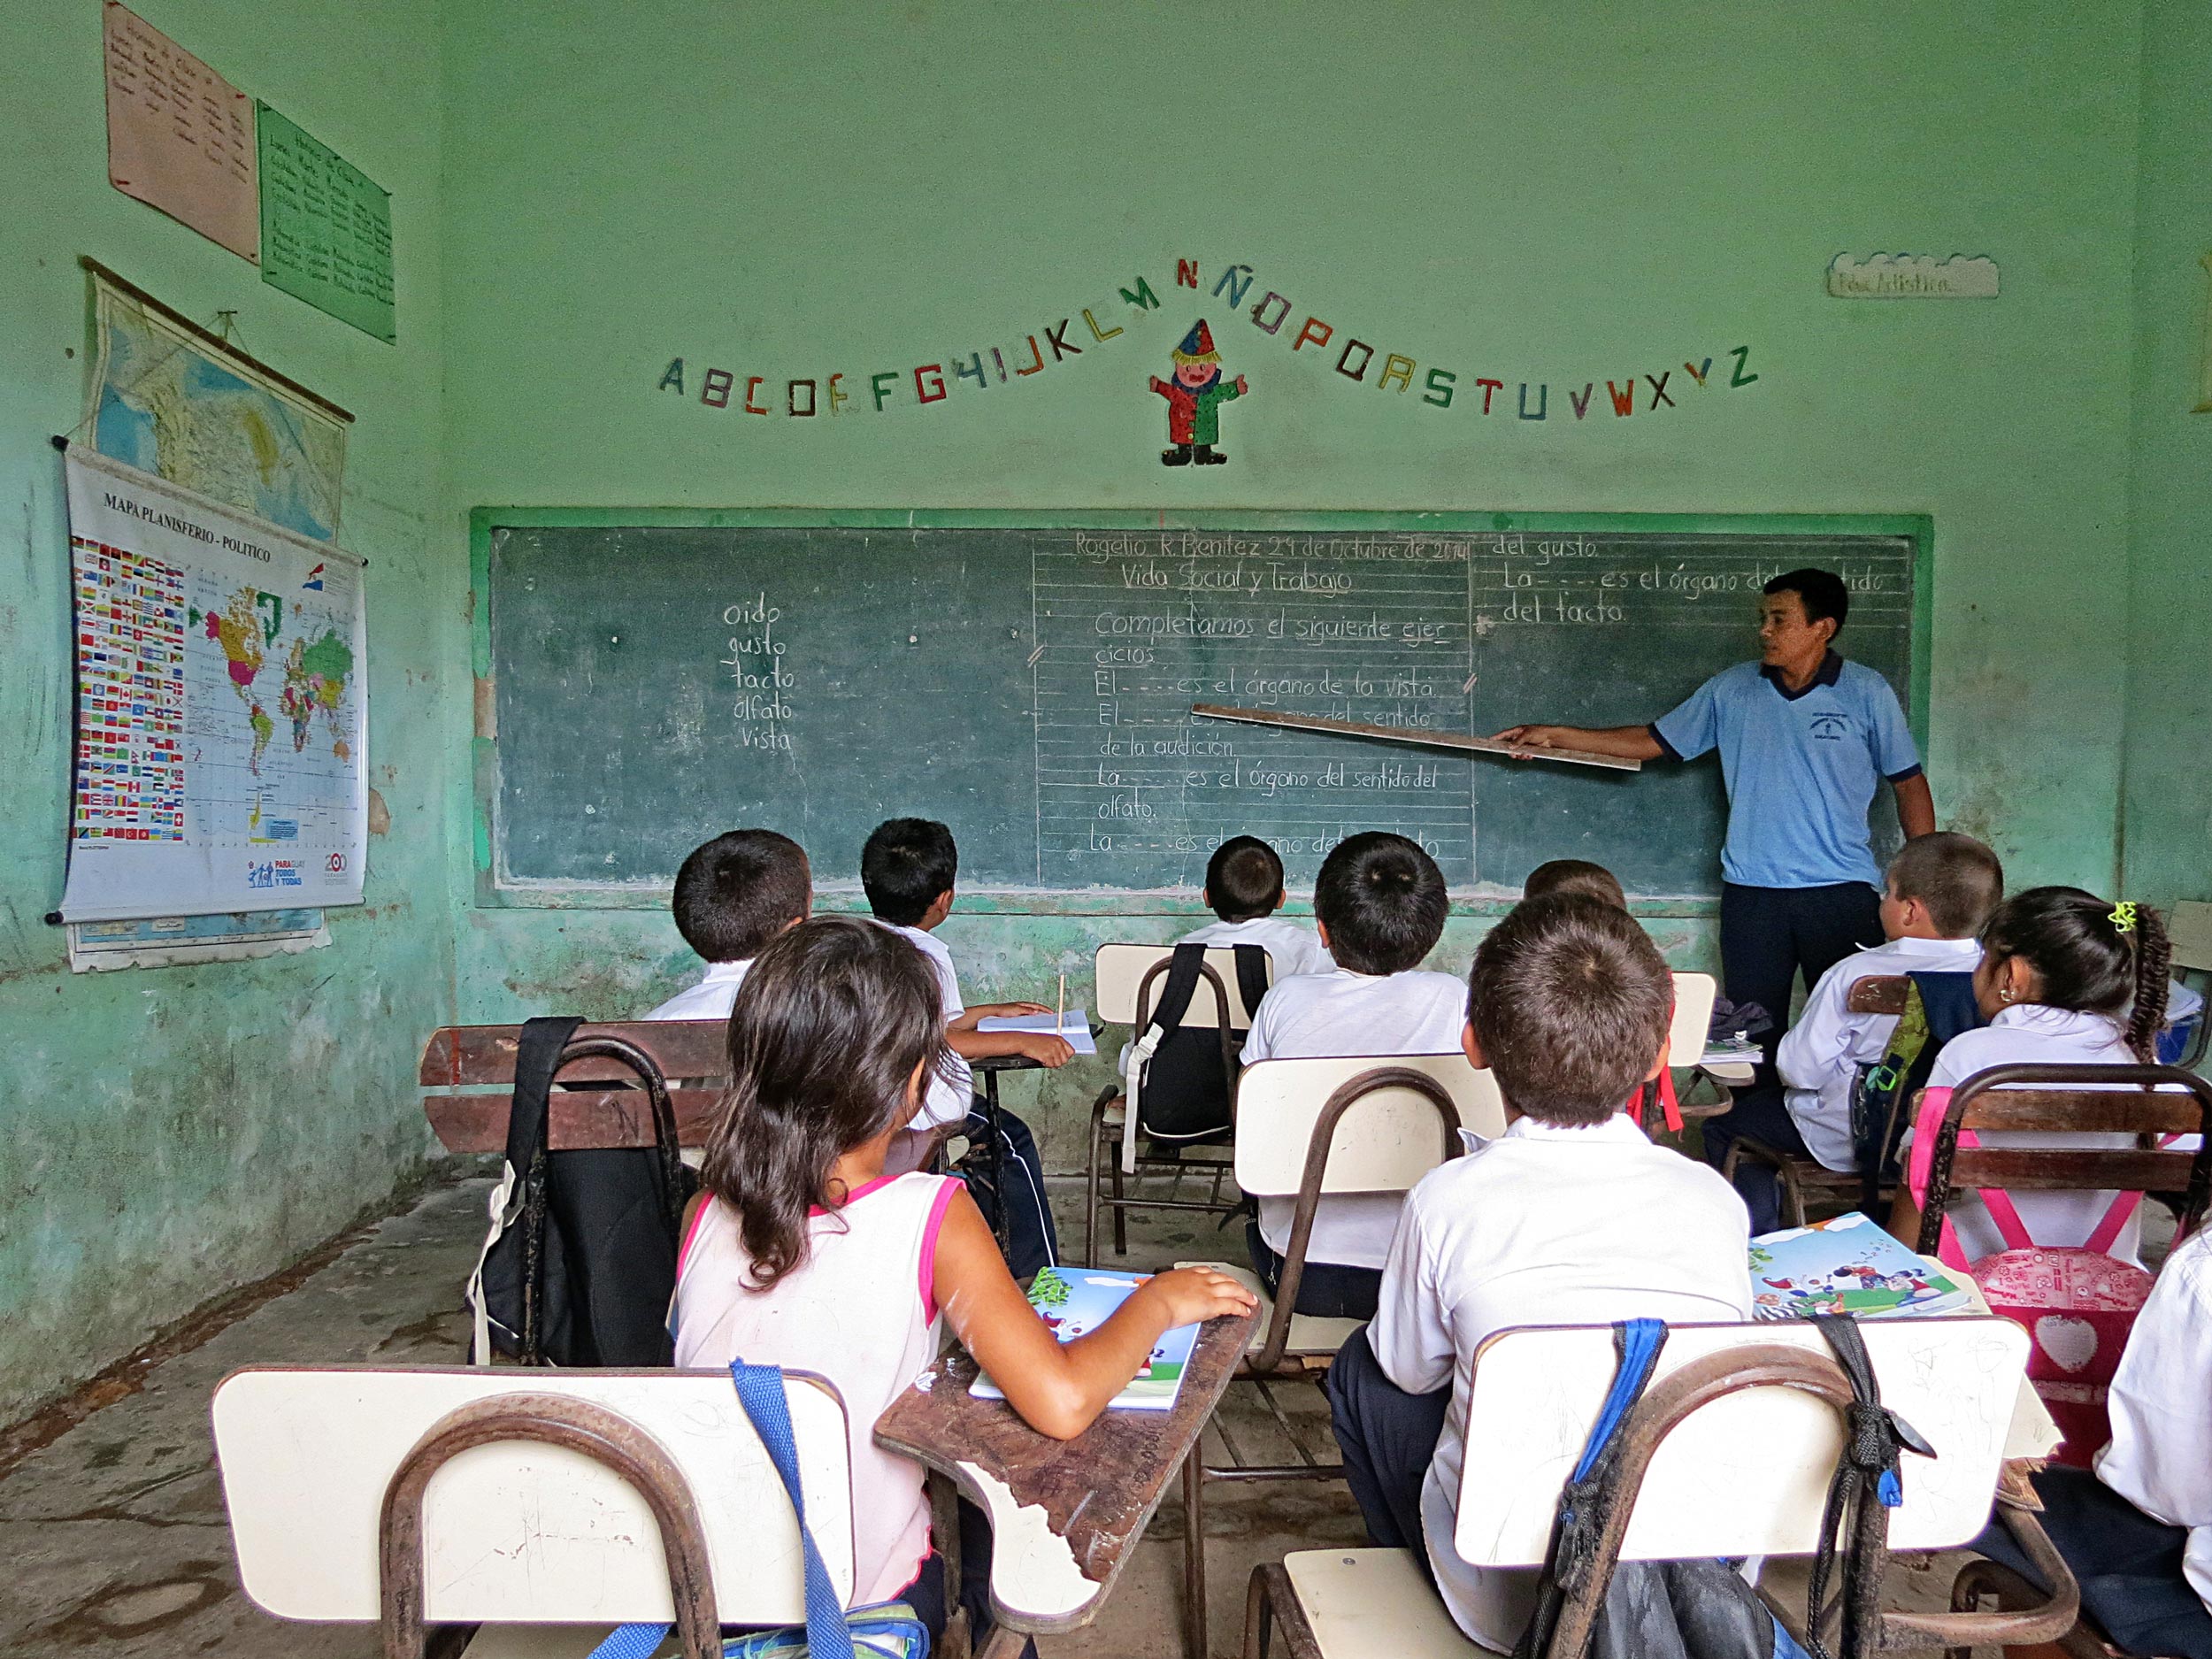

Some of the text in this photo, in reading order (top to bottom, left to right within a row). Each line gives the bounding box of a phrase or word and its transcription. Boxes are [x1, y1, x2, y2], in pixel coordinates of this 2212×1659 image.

[660, 357, 684, 396] A
[702, 368, 733, 408] B
[746, 377, 768, 415] C
[872, 372, 899, 411] F
[914, 364, 947, 403] G
[992, 347, 1007, 382] I
[1017, 335, 1044, 375] J
[1045, 319, 1082, 362] K
[1083, 309, 1124, 342] L
[1118, 276, 1160, 311] M
[1178, 258, 1198, 288] N
[1210, 265, 1254, 310] Ñ
[1293, 317, 1333, 350] P
[1423, 368, 1456, 408] S
[1476, 378, 1503, 415] T
[1518, 382, 1548, 421] U
[1570, 382, 1594, 420] V
[1607, 380, 1634, 417] W
[1646, 372, 1676, 411] X
[1730, 345, 1759, 388] Z
[104, 493, 140, 518] MAPA
[142, 507, 214, 544] PLANISFERIO
[223, 535, 270, 563] POLITICO
[1076, 533, 1146, 564] Rogelio
[1302, 535, 1324, 557] de
[1404, 536, 1425, 558] de
[1493, 534, 1598, 565] del gusto.
[1122, 559, 1351, 598] Vida Social y Trabajo
[1504, 562, 1532, 588] La
[1601, 572, 1628, 588] es
[1640, 563, 1659, 590] el
[1670, 563, 1737, 600] órgano
[1841, 561, 1883, 590] tido
[724, 591, 780, 625] oido
[1503, 591, 1540, 622] del
[1095, 604, 1255, 645] Completamos
[1268, 607, 1284, 637] el
[1295, 611, 1391, 646] siguiente
[720, 623, 786, 664] gusto
[732, 656, 795, 688] tacto
[1094, 670, 1115, 695] El
[1177, 679, 1202, 693] es
[1214, 668, 1233, 693] el
[1245, 670, 1314, 705] órgano
[1320, 669, 1343, 695] de
[1356, 671, 1372, 695] la
[733, 690, 792, 720] olfato
[1099, 701, 1118, 726] El
[1363, 702, 1430, 727] sentido
[742, 721, 791, 749] vista
[1101, 732, 1119, 756] de
[1131, 733, 1145, 756] la
[1098, 758, 1437, 796] La es el órgano del sentido del
[1090, 823, 1111, 850] La
[1176, 837, 1197, 850] es
[1207, 826, 1224, 850] el
